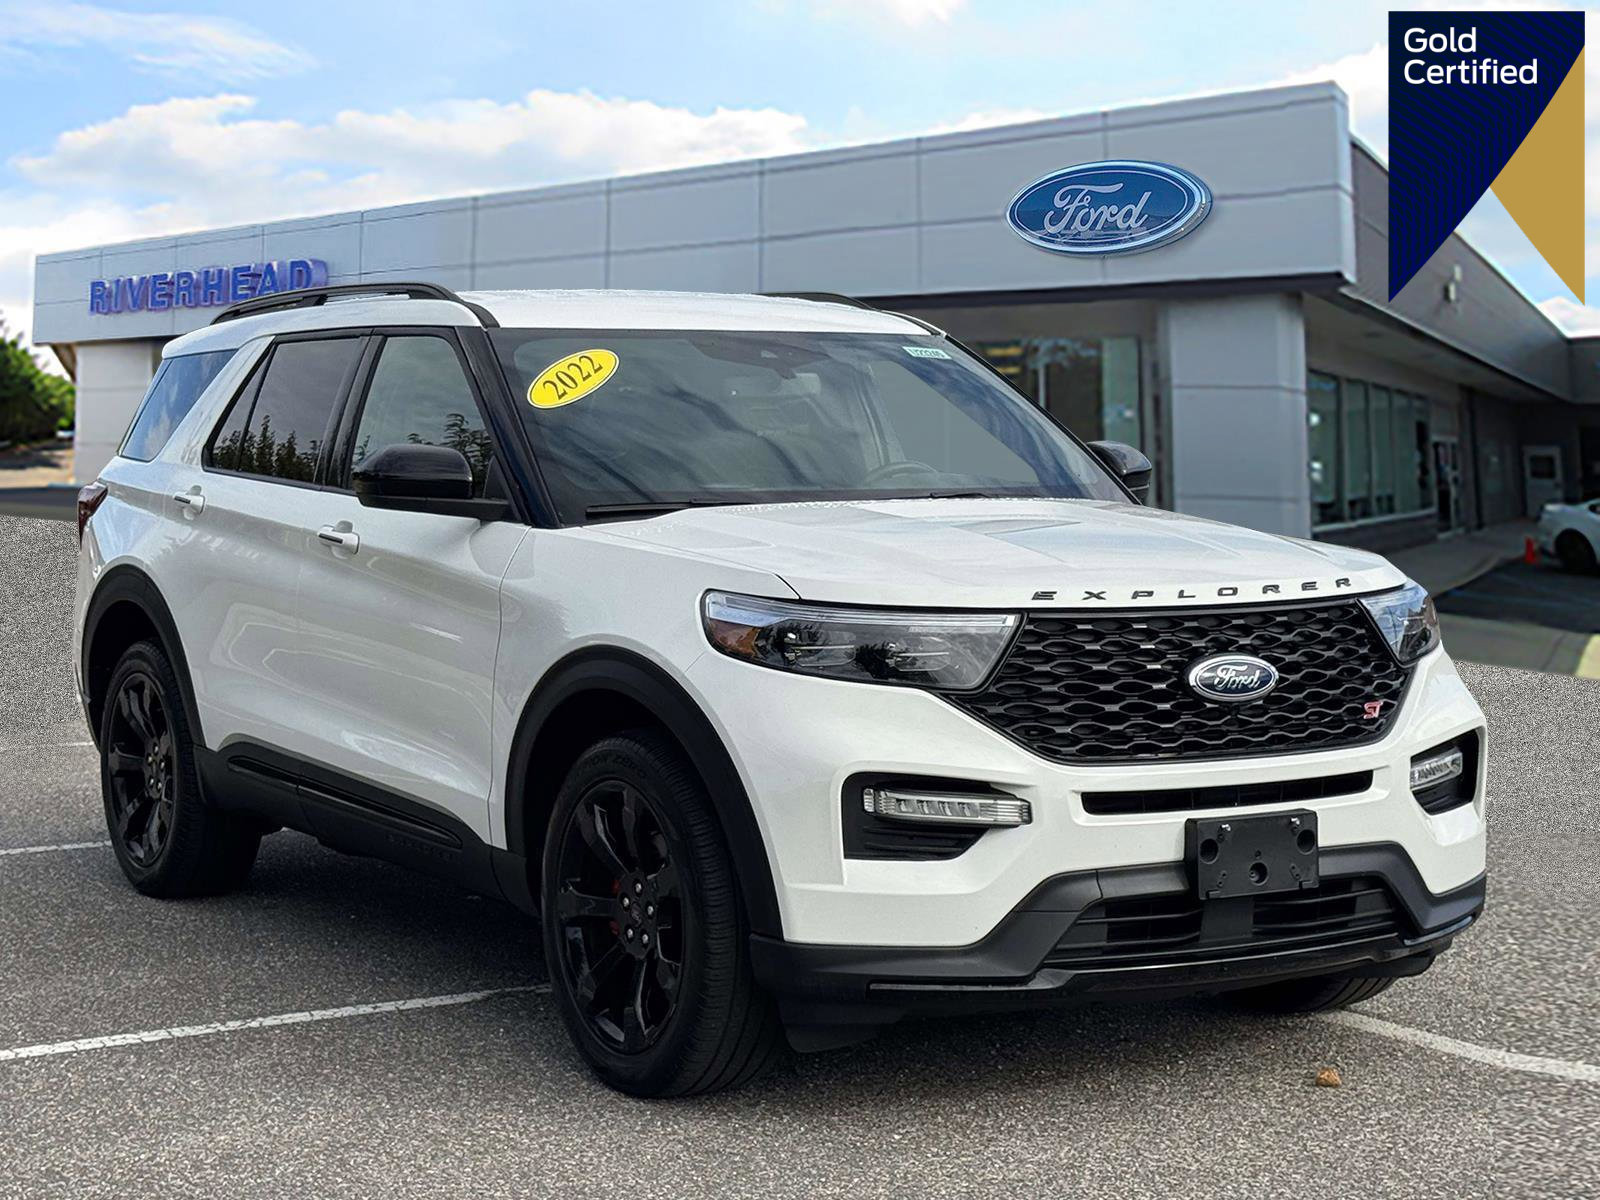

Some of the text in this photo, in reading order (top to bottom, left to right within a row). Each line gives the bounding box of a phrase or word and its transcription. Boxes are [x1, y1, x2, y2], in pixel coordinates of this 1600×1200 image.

[1043, 182, 1152, 234] Ford
[89, 258, 317, 316] RIVERHEAD
[543, 355, 603, 400] 2022
[1031, 577, 1352, 601] EXPLORER
[1213, 664, 1261, 690] Ford
[1363, 701, 1384, 719] ST
